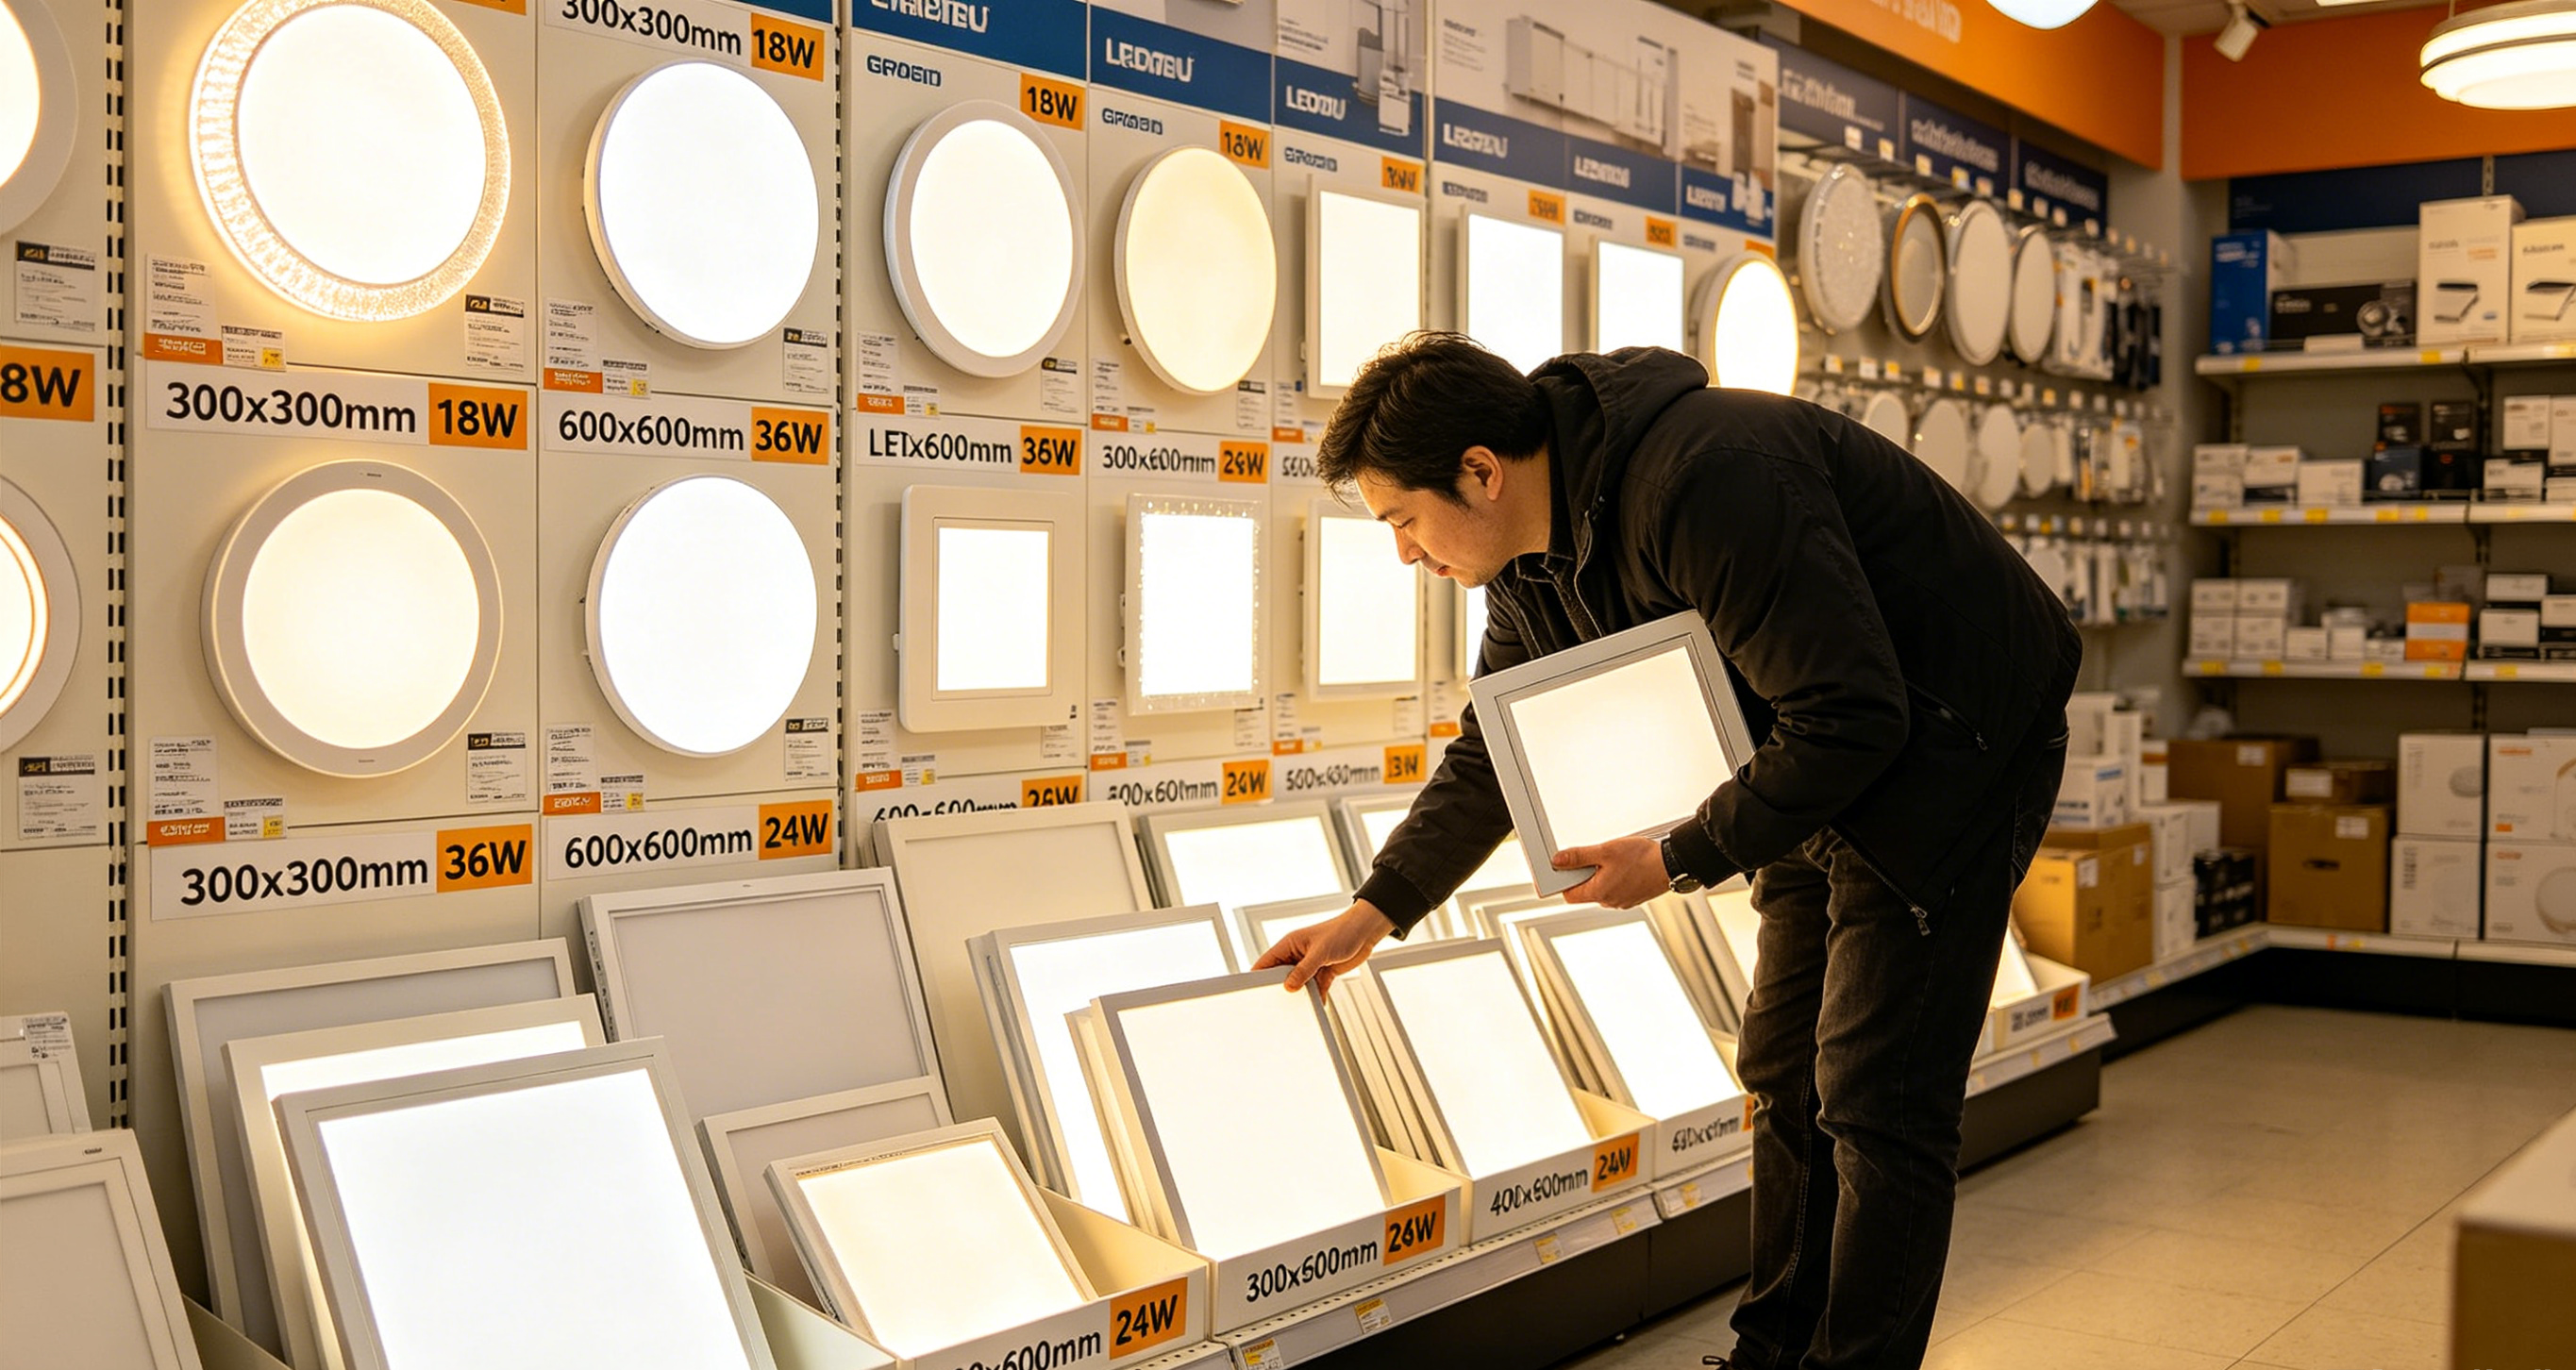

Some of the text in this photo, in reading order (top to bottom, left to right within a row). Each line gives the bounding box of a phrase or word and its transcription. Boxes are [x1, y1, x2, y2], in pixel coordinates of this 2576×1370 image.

[753, 28, 815, 69] 18W
[1027, 86, 1077, 122] 18W
[165, 381, 519, 439] 300x300mm 18W
[559, 409, 823, 455] 600x600mm 36W
[1022, 436, 1077, 467] 36W
[565, 812, 828, 869] 600x600mm 24W
[180, 839, 527, 907] 300x300mm 36W
[1115, 1294, 1179, 1346] 24W
